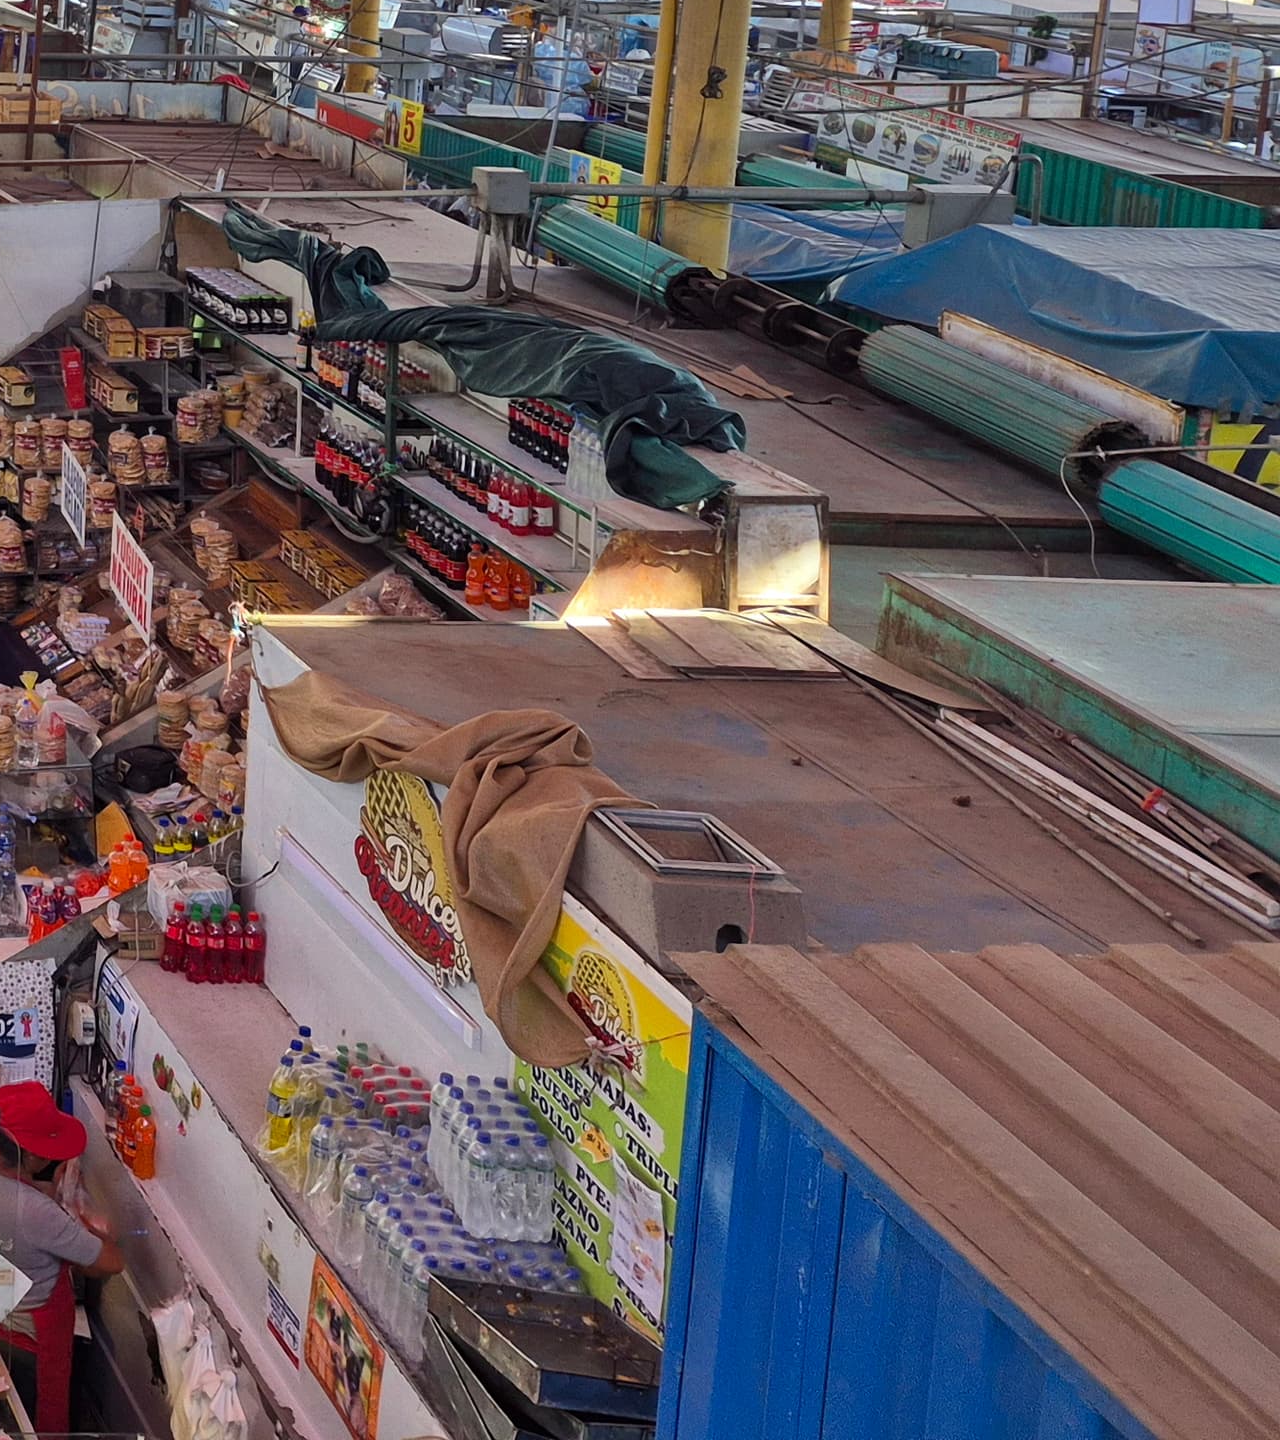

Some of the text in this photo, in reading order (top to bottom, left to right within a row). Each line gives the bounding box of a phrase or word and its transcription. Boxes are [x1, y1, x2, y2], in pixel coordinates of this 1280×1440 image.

[403, 112, 416, 143] 5
[111, 552, 149, 633] NATURAL
[531, 1066, 580, 1122] QUESO
[553, 1065, 592, 1108] ABES
[530, 1086, 575, 1146] POLLO
[554, 1173, 600, 1234] AZNO
[575, 1163, 612, 1213] PYE:
